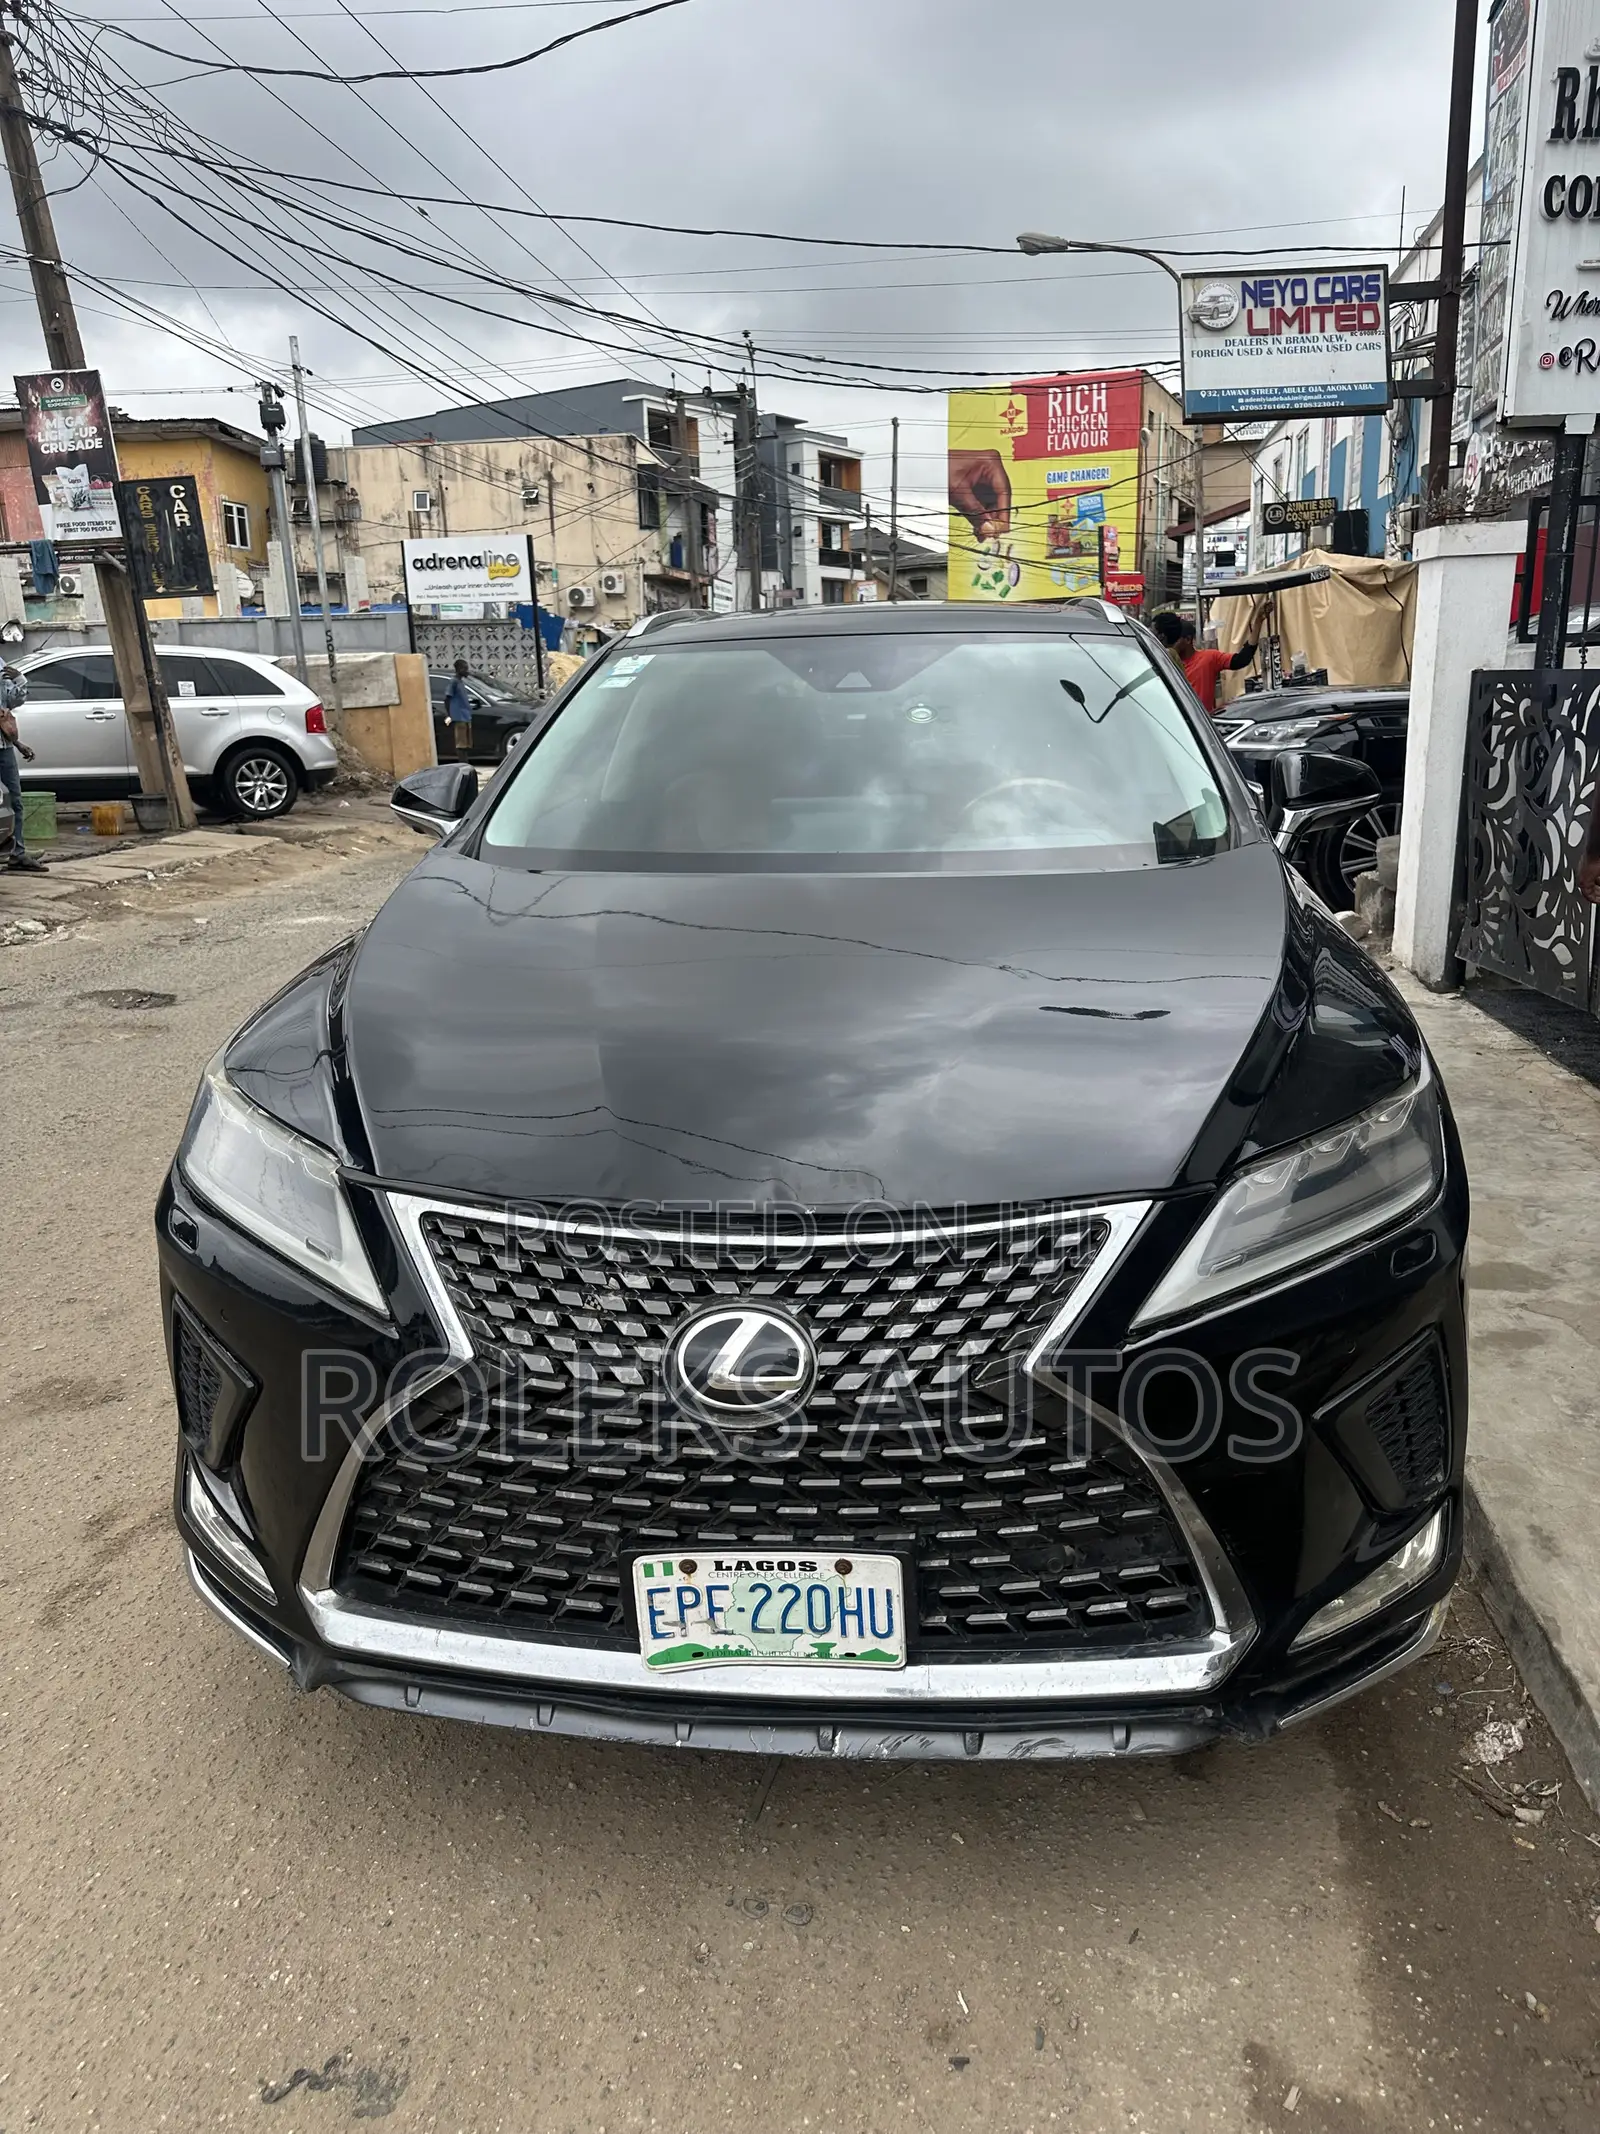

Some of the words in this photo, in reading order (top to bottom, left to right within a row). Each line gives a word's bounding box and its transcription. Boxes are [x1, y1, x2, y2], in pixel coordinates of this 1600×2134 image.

[1544, 174, 1600, 219] CO
[1241, 278, 1308, 309] NEYO
[1314, 274, 1381, 304] CARS
[1247, 303, 1381, 336] LIMITED
[1191, 348, 1234, 358] FOREIGN
[1237, 346, 1263, 357] USED
[1266, 346, 1274, 356] &
[1277, 344, 1323, 355] NIGERIAN
[1326, 342, 1352, 352] USED
[1355, 341, 1382, 351] CARS
[1225, 337, 1268, 347] DEALERS
[1272, 336, 1282, 345] IN
[1285, 335, 1320, 345] BRAND
[1559, 338, 1600, 374] @R
[1207, 389, 1220, 398] 32,
[1221, 388, 1249, 397] LAWANI
[1251, 387, 1281, 397] STREET,
[1282, 386, 1307, 395] ABULE
[1326, 384, 1352, 393] AKOKA
[1048, 382, 1107, 418] RICH
[45, 415, 86, 429] MEGA
[1047, 412, 1108, 434] CHICKEN
[38, 426, 98, 443] LIGHT-UP
[1047, 430, 1109, 452] FLAVOUR
[40, 437, 104, 454] CRUSADE
[136, 486, 155, 518] CARS
[169, 484, 192, 528] CAR
[1286, 500, 1318, 513] AUNTIE
[56, 521, 71, 529] FREE
[412, 549, 520, 571] adrenaline
[489, 567, 510, 575] lounge
[483, 581, 514, 589] champion
[714, 1560, 818, 1572] LAGOS
[708, 1571, 742, 1579] CENTRE
[747, 1571, 762, 1580] OF
[764, 1571, 825, 1580] EXCELLENCE
